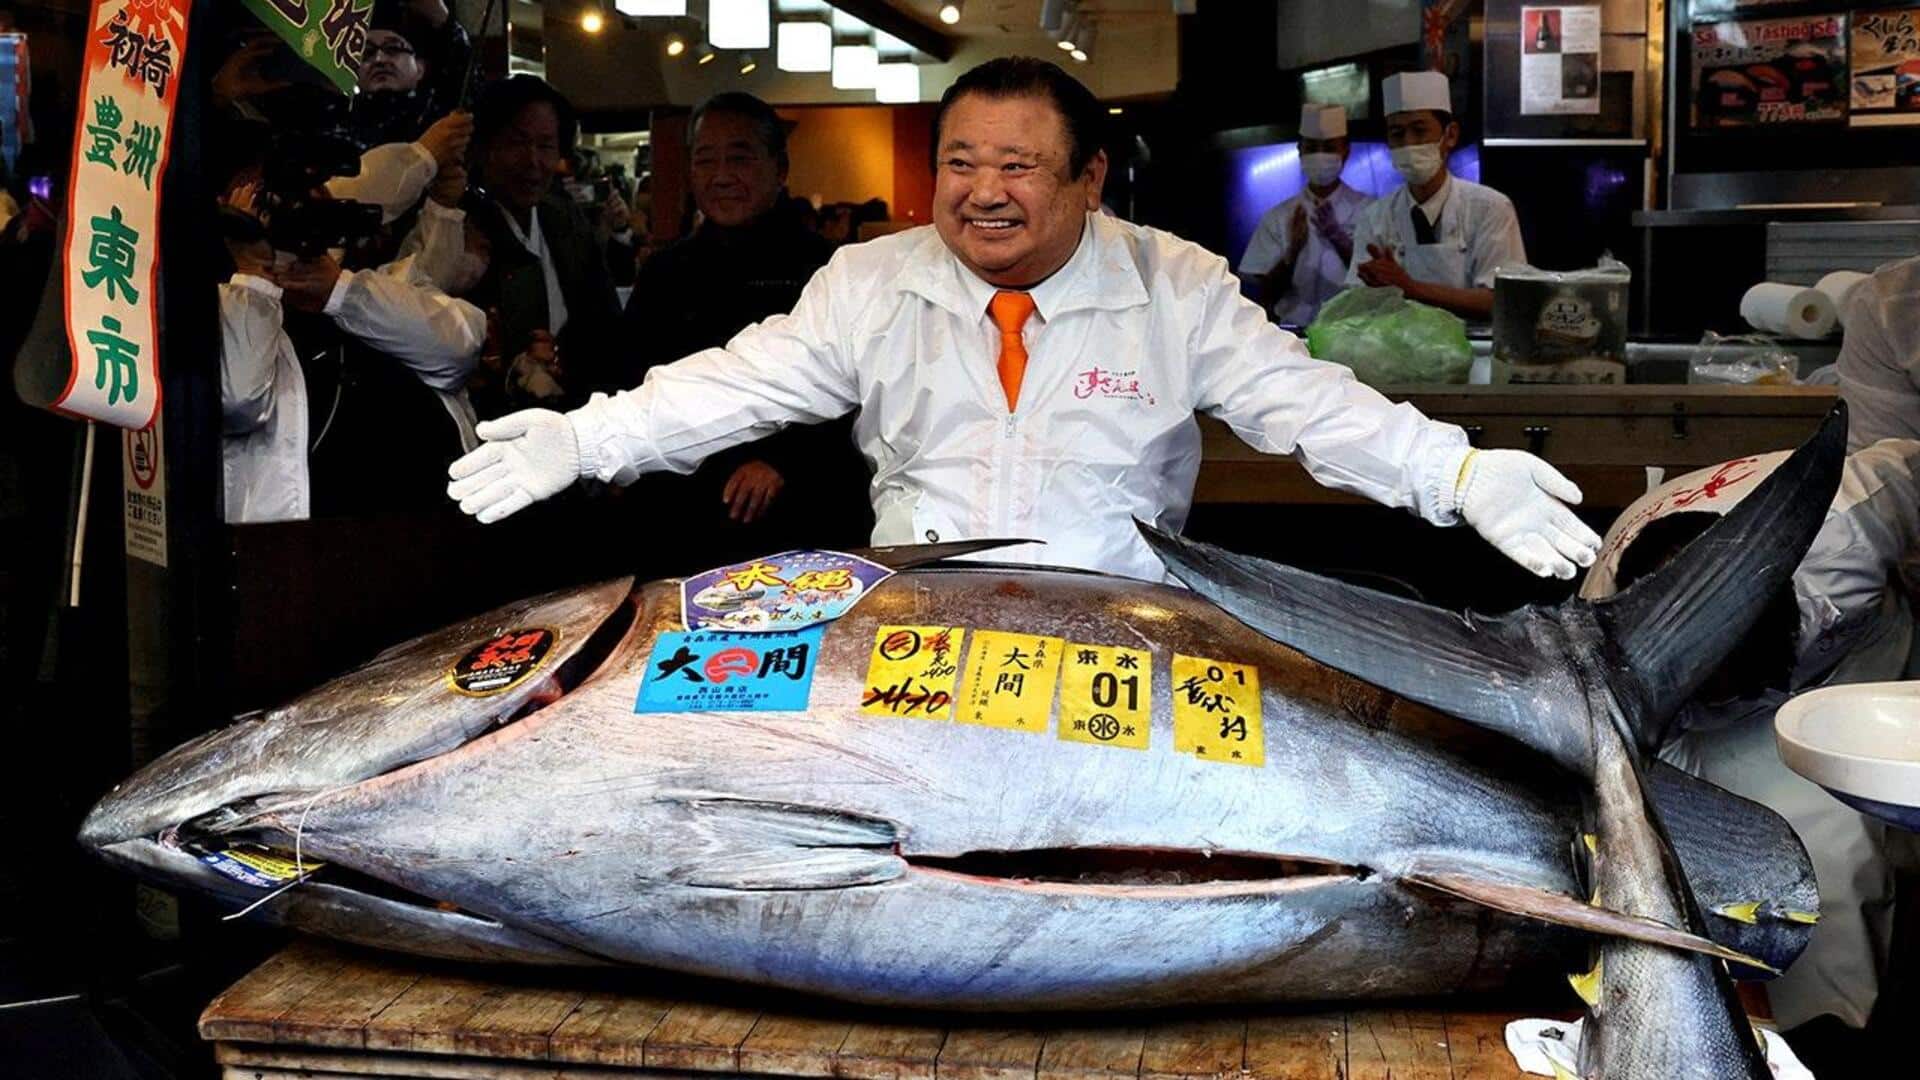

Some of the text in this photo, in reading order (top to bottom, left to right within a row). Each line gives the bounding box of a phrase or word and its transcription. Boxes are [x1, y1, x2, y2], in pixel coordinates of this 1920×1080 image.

[101, 9, 172, 99] 初荷
[1695, 29, 1749, 46] Saln
[85, 95, 162, 191] 豊洲
[81, 205, 140, 406] 東市
[994, 646, 1031, 699] 大間
[1091, 672, 1139, 711] 01
[1206, 665, 1246, 686] 01
